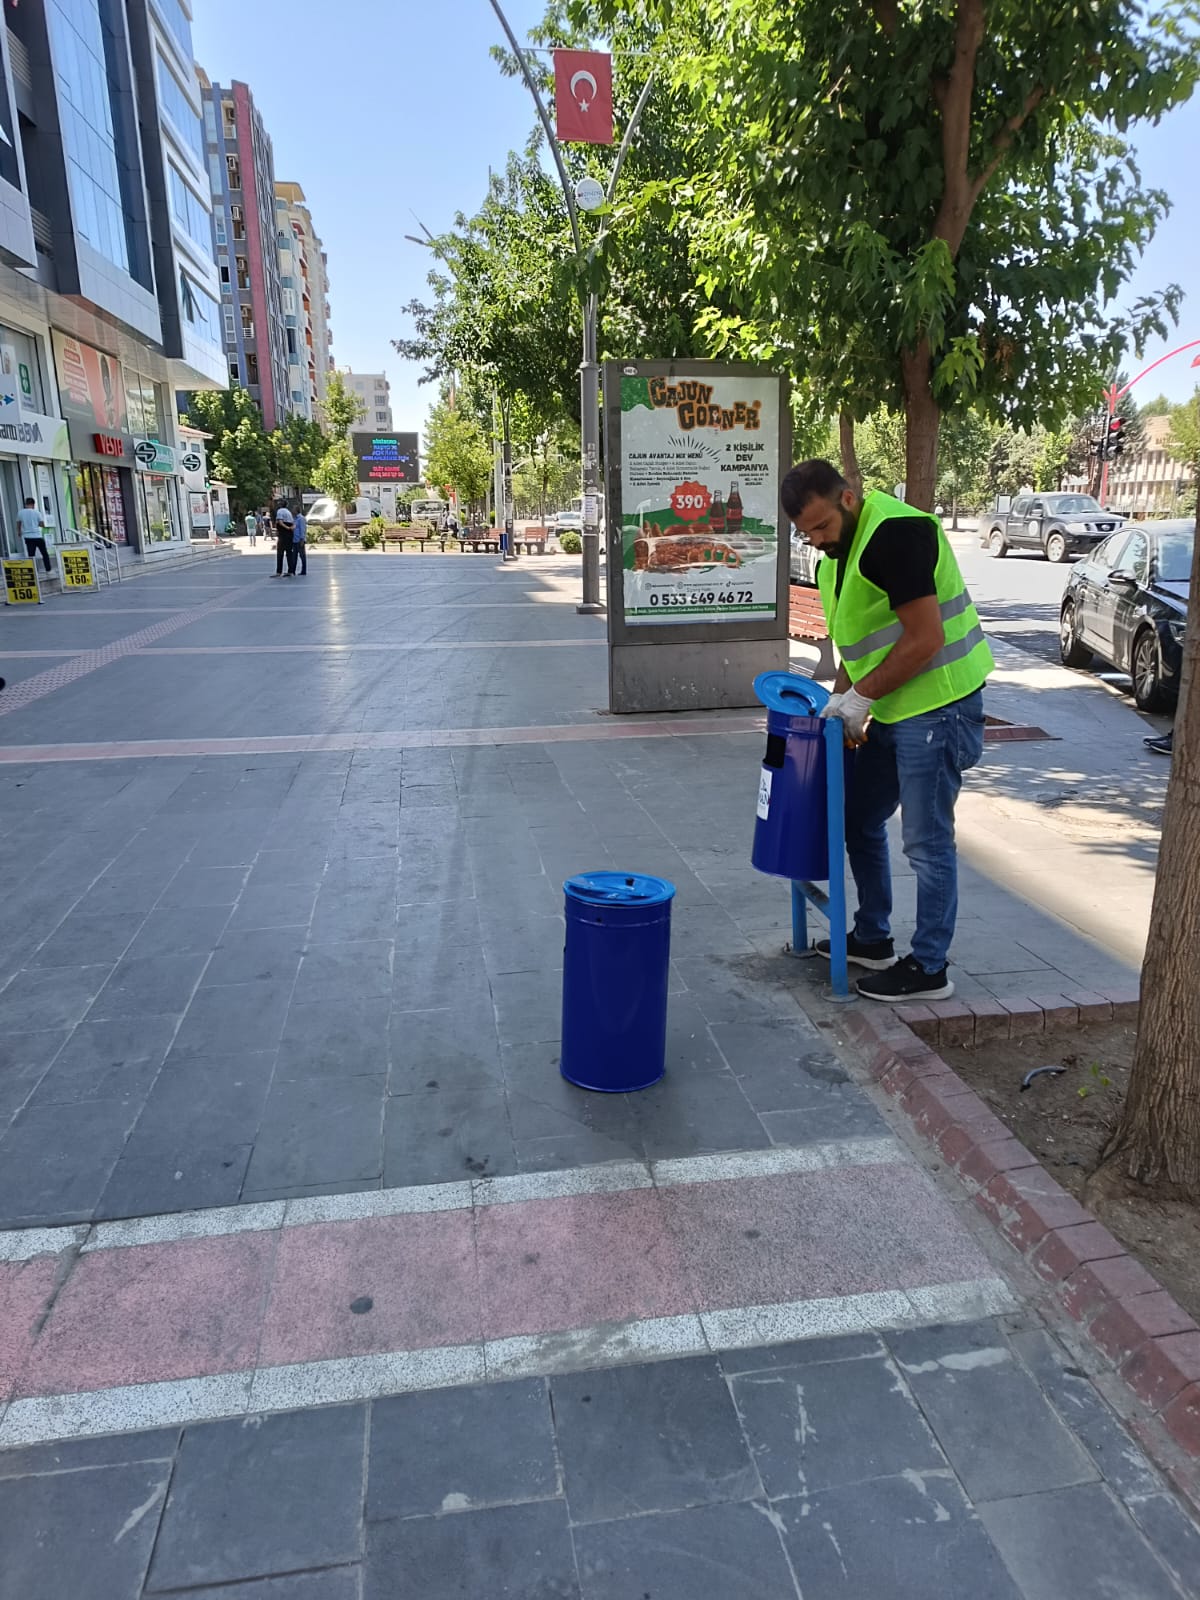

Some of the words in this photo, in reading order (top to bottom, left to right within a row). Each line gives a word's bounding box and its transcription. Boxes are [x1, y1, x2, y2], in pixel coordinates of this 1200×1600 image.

[649, 376, 713, 407] CAJUN
[678, 401, 761, 430] CORNER
[733, 442, 765, 452] KİŞİLİK
[736, 453, 753, 461] DEV
[720, 463, 769, 472] KAMPANYA
[650, 594, 658, 606] 0
[718, 591, 734, 604] 46
[737, 590, 753, 603] 72
